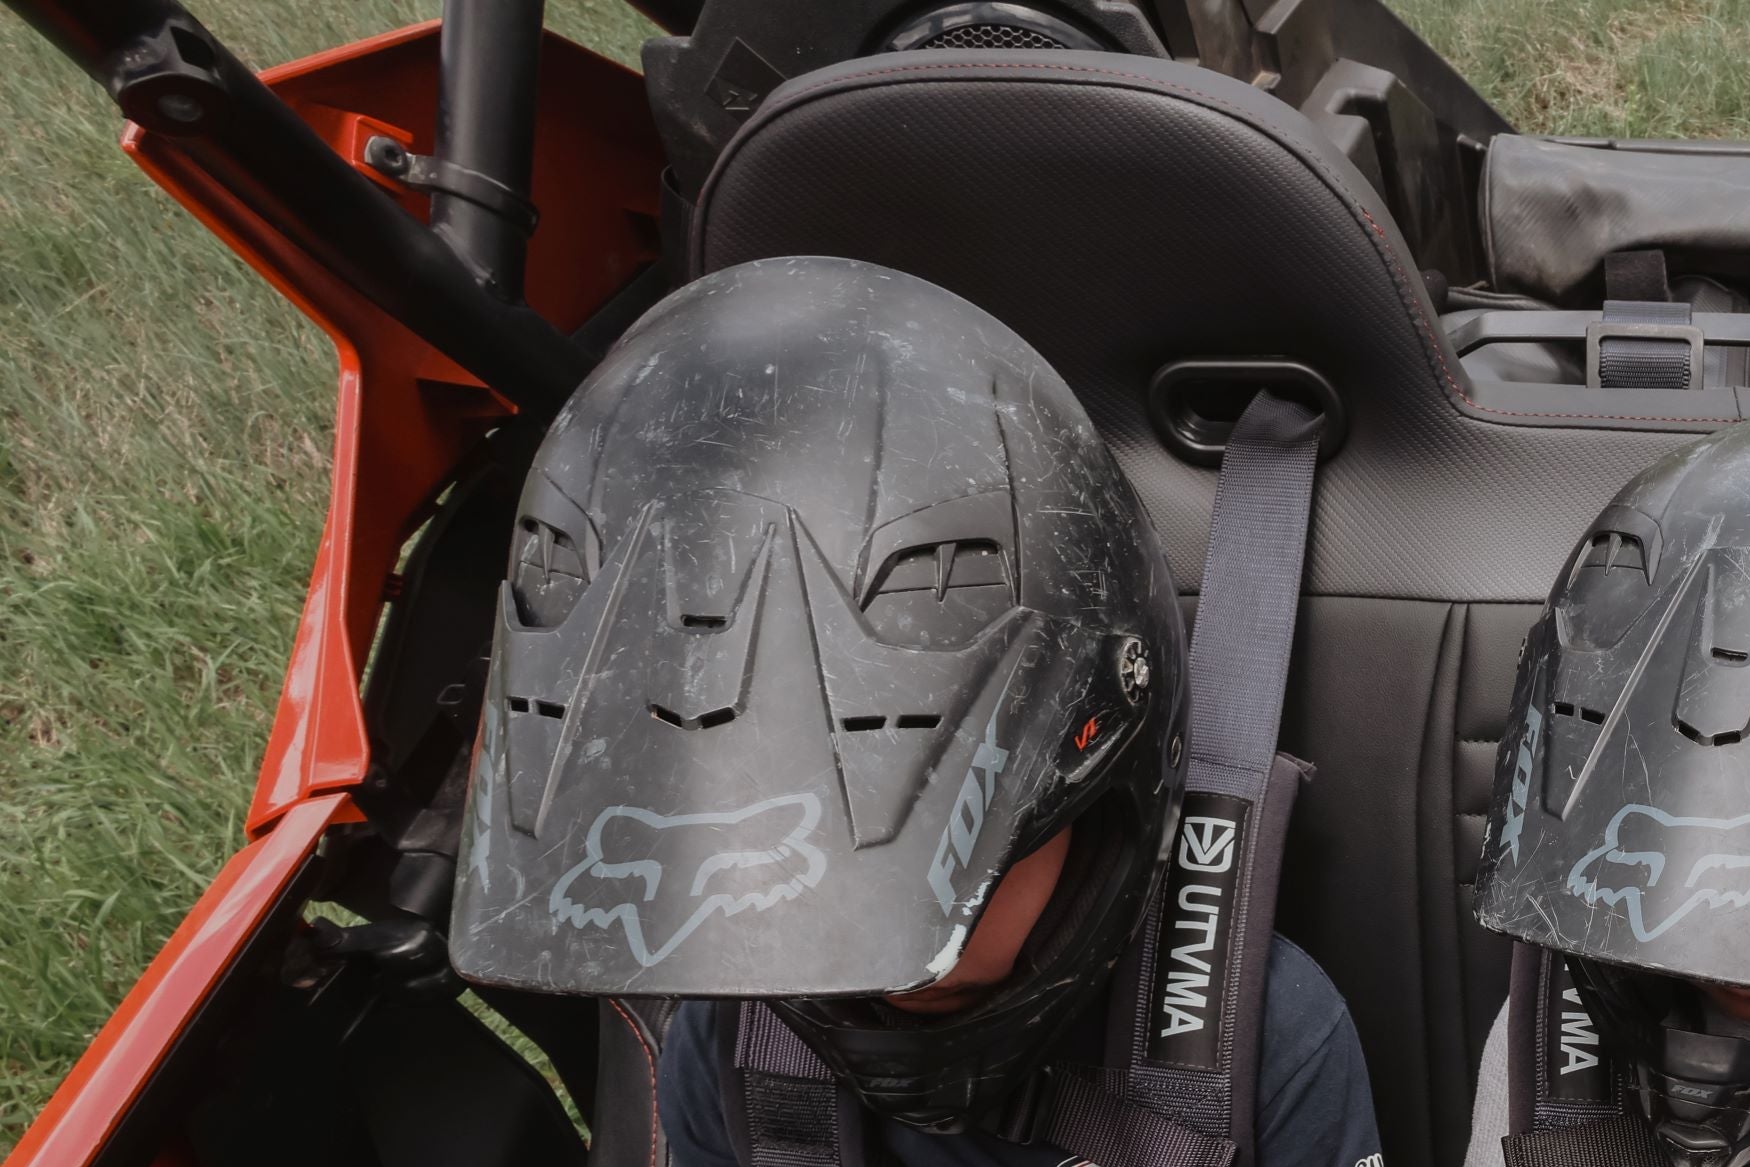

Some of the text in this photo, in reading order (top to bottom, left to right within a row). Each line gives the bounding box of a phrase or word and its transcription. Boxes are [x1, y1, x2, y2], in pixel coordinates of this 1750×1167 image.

[926, 676, 1012, 919] FOX
[1499, 703, 1543, 869] FOX
[1160, 884, 1223, 1038] UTVMA
[1560, 963, 1600, 1076] VMA
[1671, 1084, 1715, 1099] FOX
